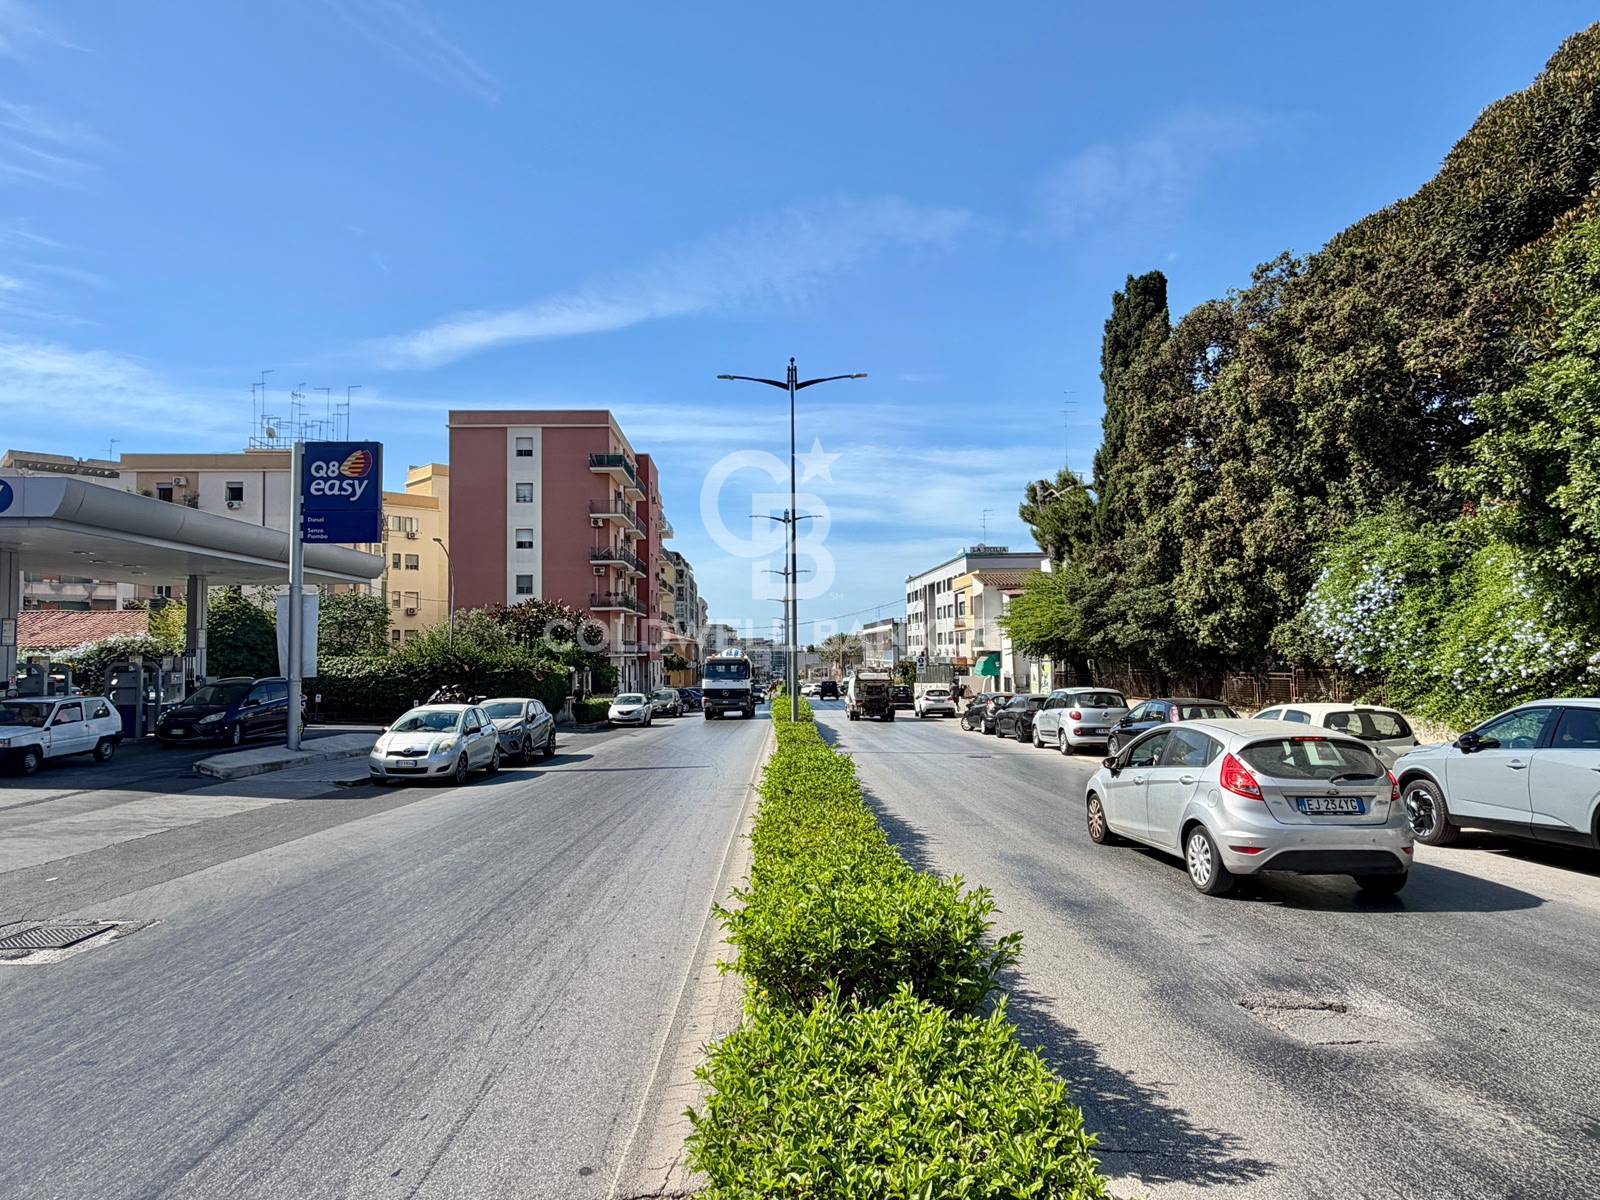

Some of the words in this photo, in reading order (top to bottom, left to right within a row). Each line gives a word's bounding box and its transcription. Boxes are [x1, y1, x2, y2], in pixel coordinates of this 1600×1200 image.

[311, 461, 339, 477] Q8
[310, 479, 369, 501] easy
[1306, 799, 1321, 811] EJ
[1325, 799, 1357, 811] 234YG
